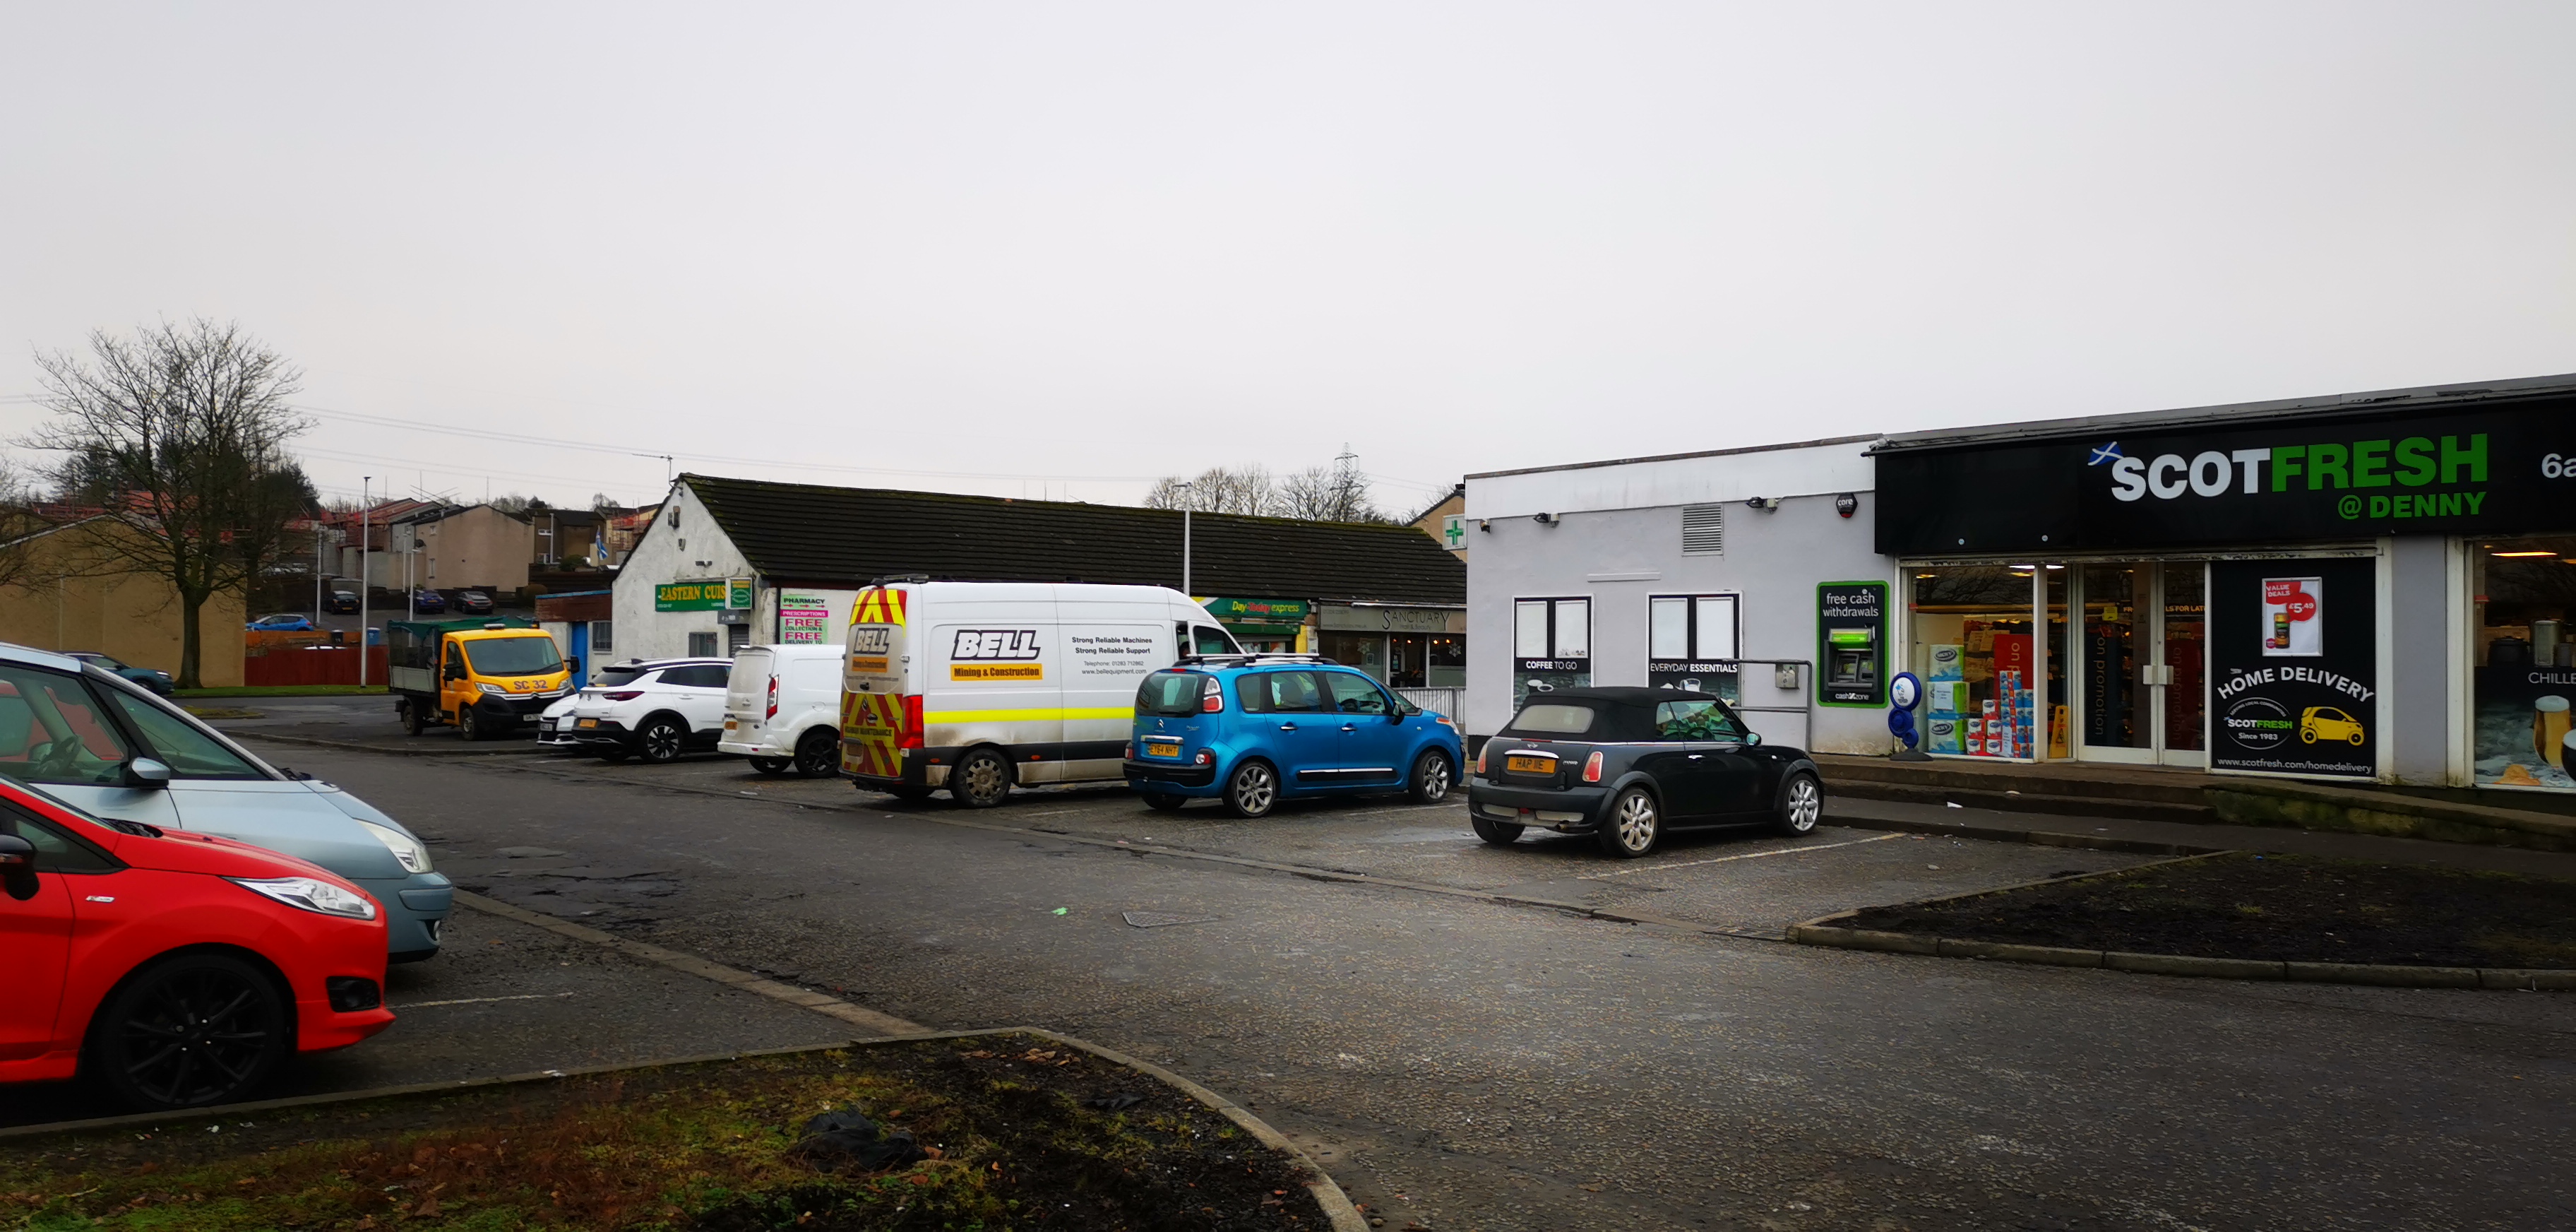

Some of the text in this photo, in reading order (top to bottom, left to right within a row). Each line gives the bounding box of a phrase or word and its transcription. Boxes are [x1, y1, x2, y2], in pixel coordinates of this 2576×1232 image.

[2111, 433, 2488, 502] SCOTFRESH
[2337, 492, 2486, 520] @ DENNY
[661, 586, 701, 600] EASTERN
[704, 585, 726, 599] CUIS
[1826, 592, 1876, 605] free cash
[1272, 604, 1300, 614] express
[1823, 605, 1879, 617] withdrawals
[785, 618, 823, 627] FREE
[1382, 610, 1450, 631] SANCTUARY
[785, 632, 823, 641] FREE
[853, 627, 890, 655] BELL
[950, 629, 1042, 660] BELL
[1525, 661, 1578, 670] COFFEE TO GO
[1650, 663, 1738, 673] EVERYDAY ESSENTIALS
[953, 666, 1040, 678] Mining & Construction
[513, 680, 548, 690] SC 32
[2092, 636, 2108, 735] on promotion
[2217, 667, 2375, 702] HOME DELIVERY
[2227, 718, 2293, 729] SCOTFRESH
[1515, 758, 1533, 769] HAP
[2217, 758, 2373, 774] www.scotfresh.com/homedelivery
